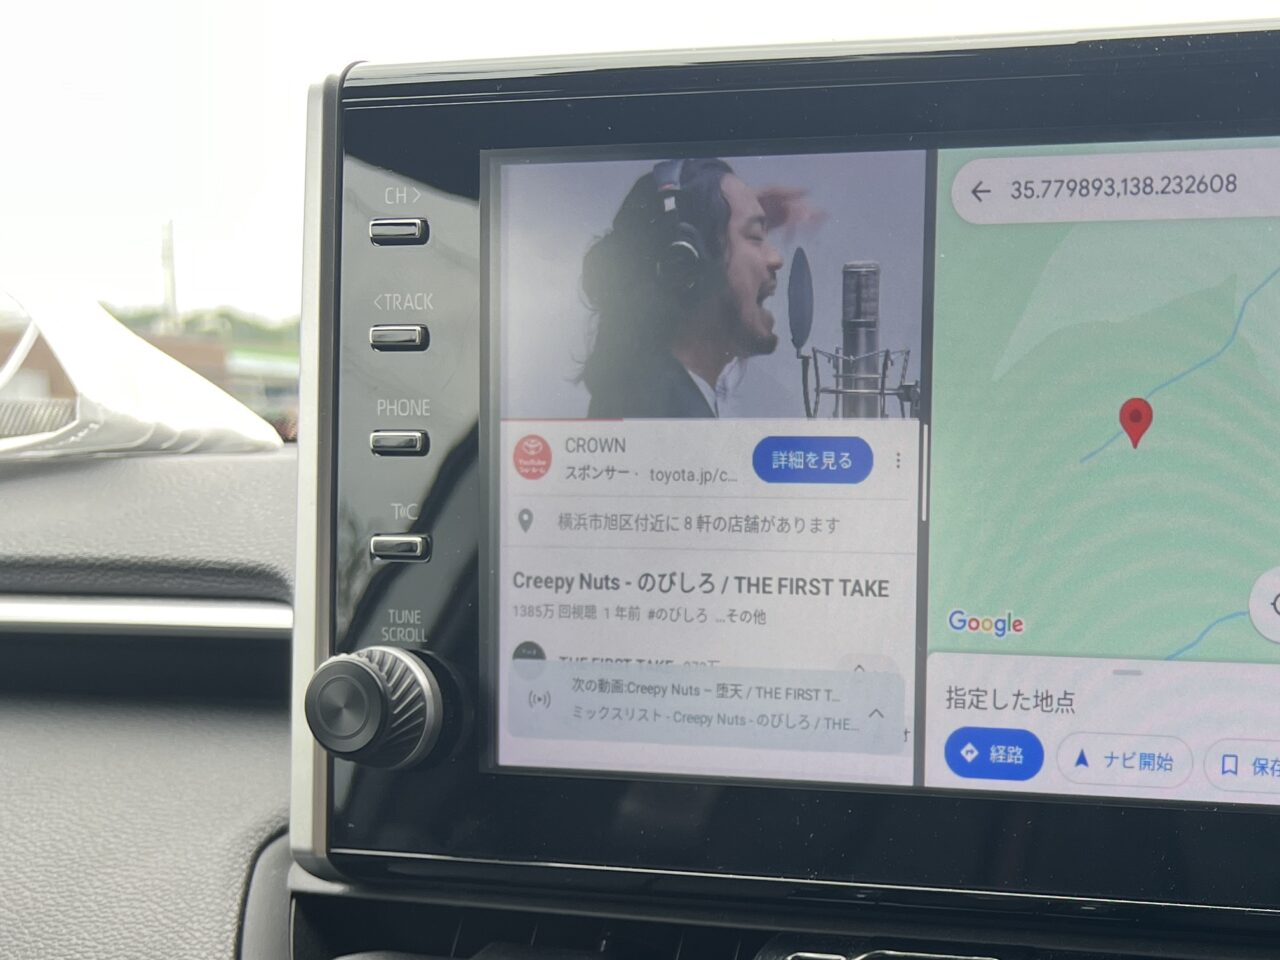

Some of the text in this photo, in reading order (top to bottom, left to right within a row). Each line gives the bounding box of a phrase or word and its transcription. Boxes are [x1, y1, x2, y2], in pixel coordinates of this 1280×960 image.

[1010, 174, 1238, 202] 35.779893,138.232608
[377, 398, 431, 417] PHONE
[565, 437, 626, 453] CROWN
[771, 449, 853, 471] 詳細を見る
[512, 571, 575, 595] Creepy
[579, 573, 621, 591] Nuts
[637, 572, 716, 595] のびしろ
[734, 576, 773, 595] THE
[778, 577, 835, 597] FIRST
[839, 579, 890, 598] TAKE
[388, 608, 421, 624] TUNE
[948, 609, 1025, 638] Google
[381, 626, 428, 643] SCROLL
[671, 682, 700, 697] Nuts
[756, 686, 782, 700] THE
[785, 687, 818, 701] FIRST
[945, 685, 1077, 715] 指定した地点
[572, 704, 662, 722] ミックスリスト
[673, 709, 716, 729] Creepy
[718, 713, 746, 727] Nuts
[756, 713, 810, 731] のびしろ
[989, 744, 1024, 765] 経路
[1103, 751, 1174, 773] ナビ開始
